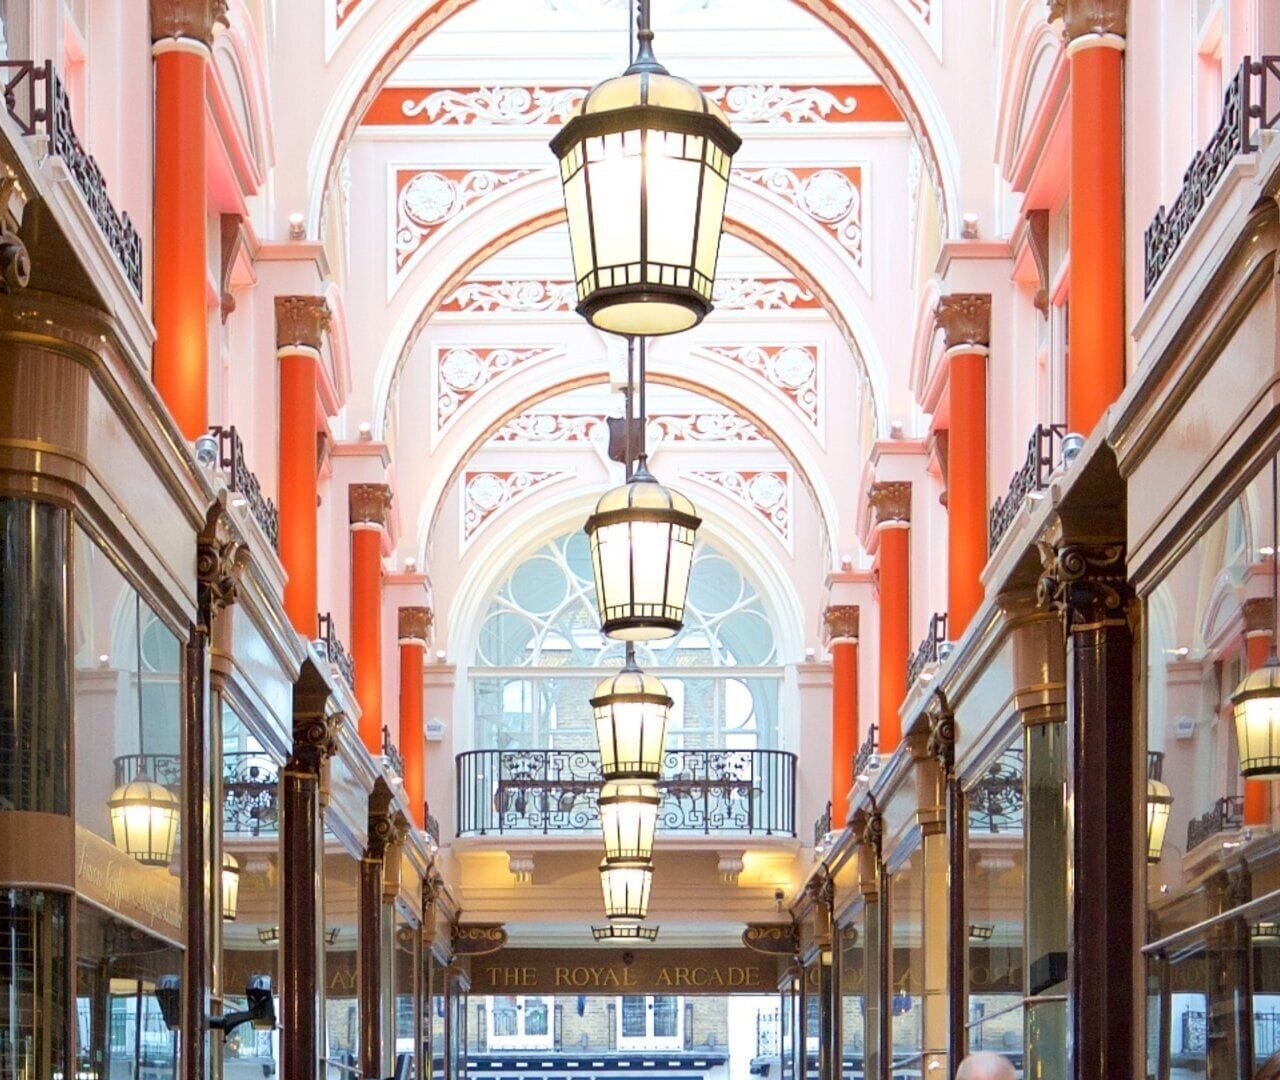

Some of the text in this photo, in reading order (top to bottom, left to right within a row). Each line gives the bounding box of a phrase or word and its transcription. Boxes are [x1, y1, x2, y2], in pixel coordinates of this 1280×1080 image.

[486, 966, 761, 987] THE ROYAL ARCADE
